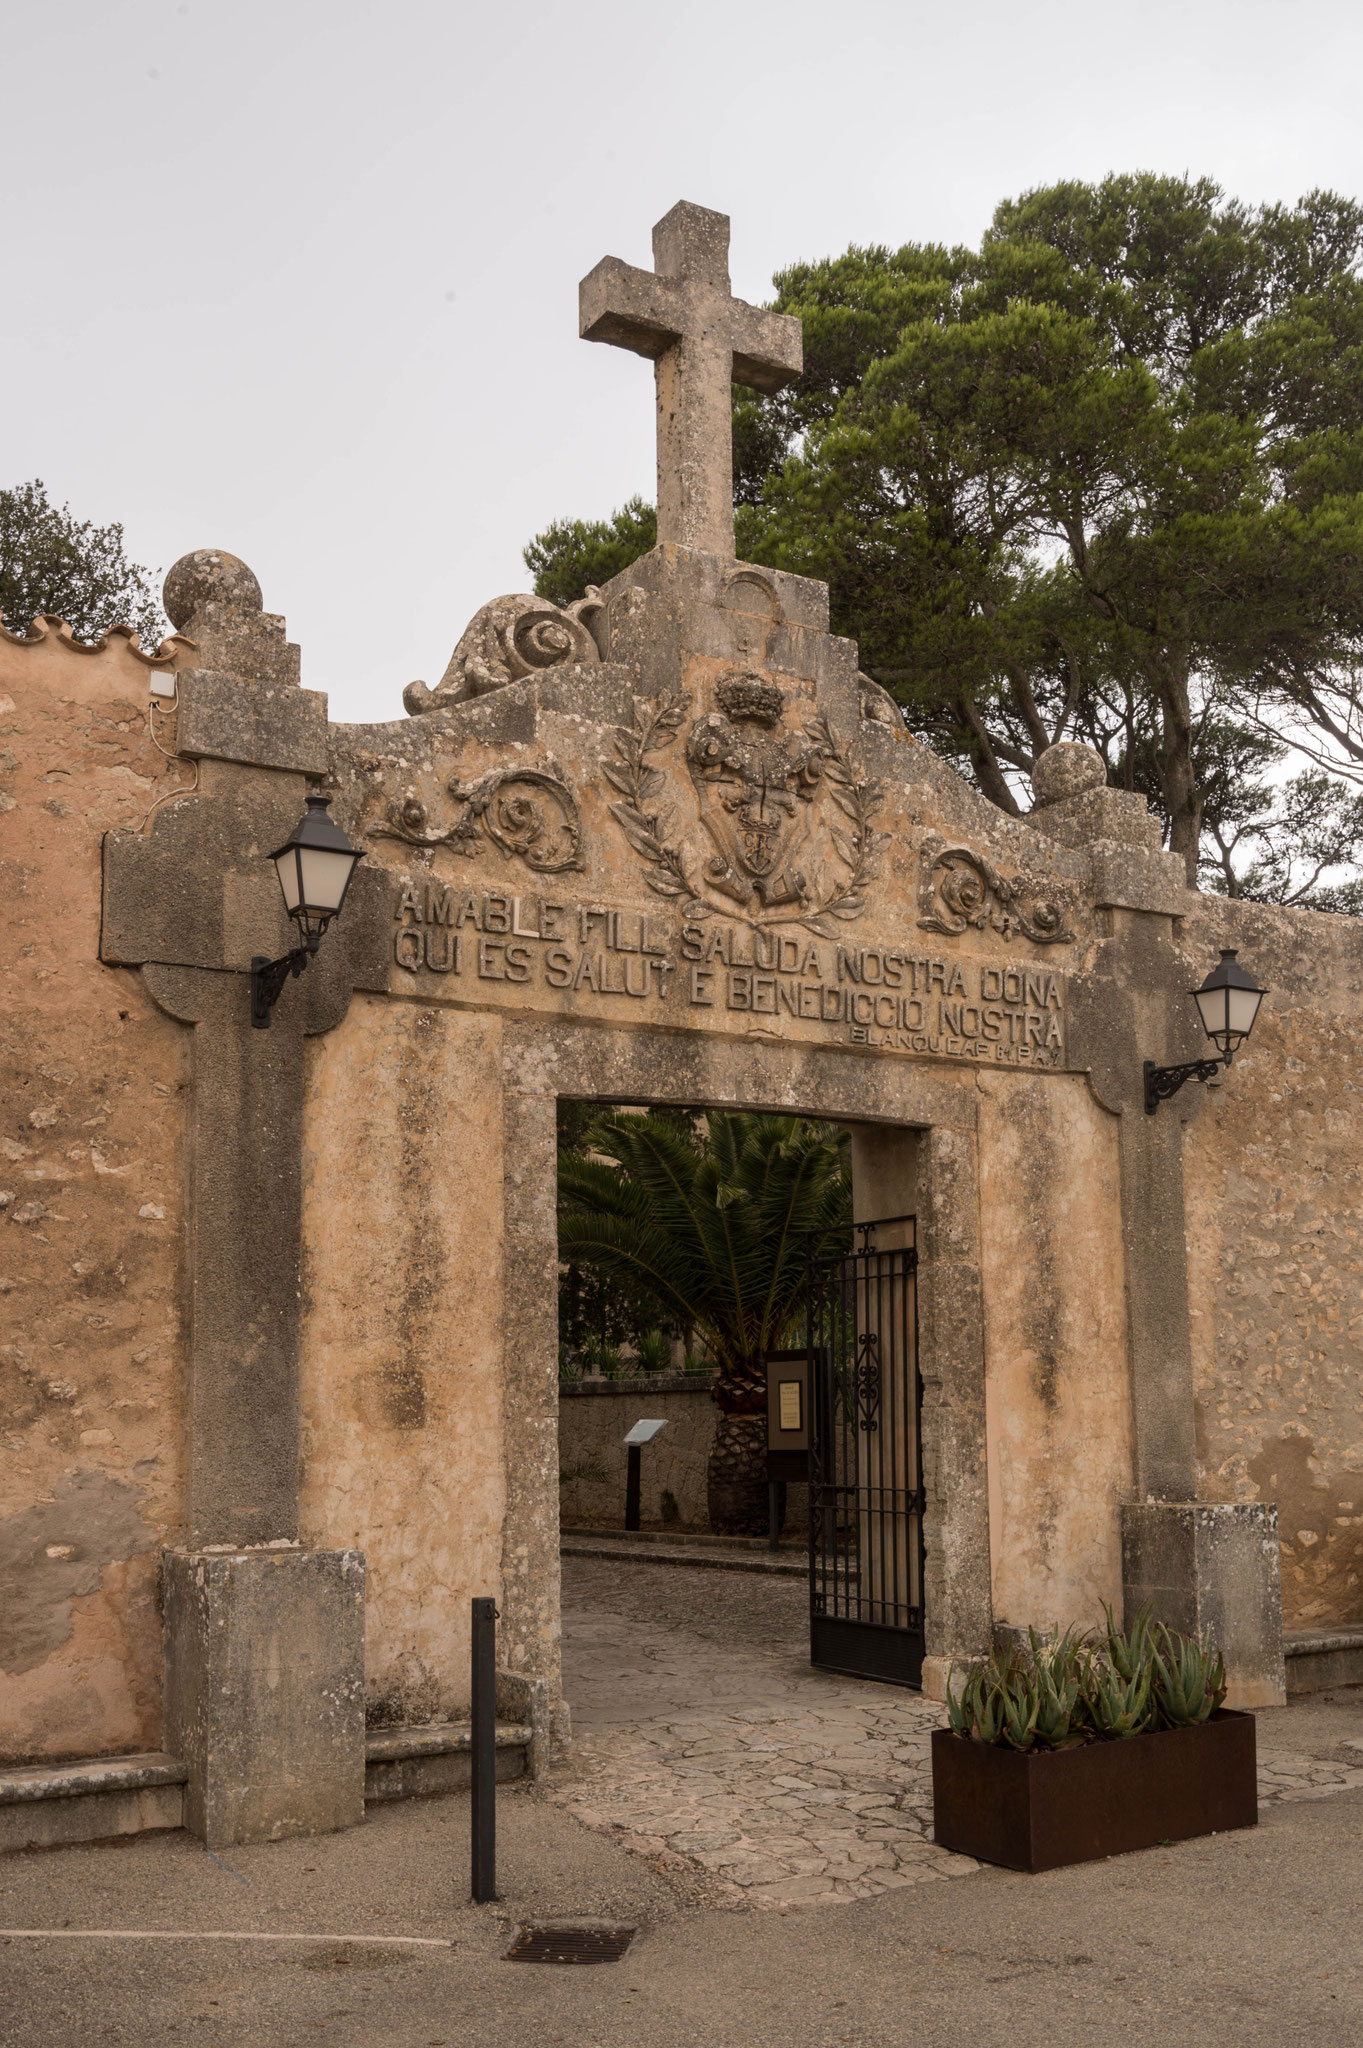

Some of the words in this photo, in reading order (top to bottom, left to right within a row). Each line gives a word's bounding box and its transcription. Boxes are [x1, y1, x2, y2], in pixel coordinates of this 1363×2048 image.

[394, 882, 564, 941] AMABLE
[576, 904, 666, 956] FILL
[682, 923, 822, 979] SALUDA
[837, 944, 968, 998] NOSTRA
[981, 966, 1063, 1010] DONA
[394, 928, 463, 975] QUI
[478, 938, 532, 983] ES
[545, 948, 676, 998] SALUT
[690, 966, 714, 1004] E
[938, 1000, 1063, 1048] NOSTRA
